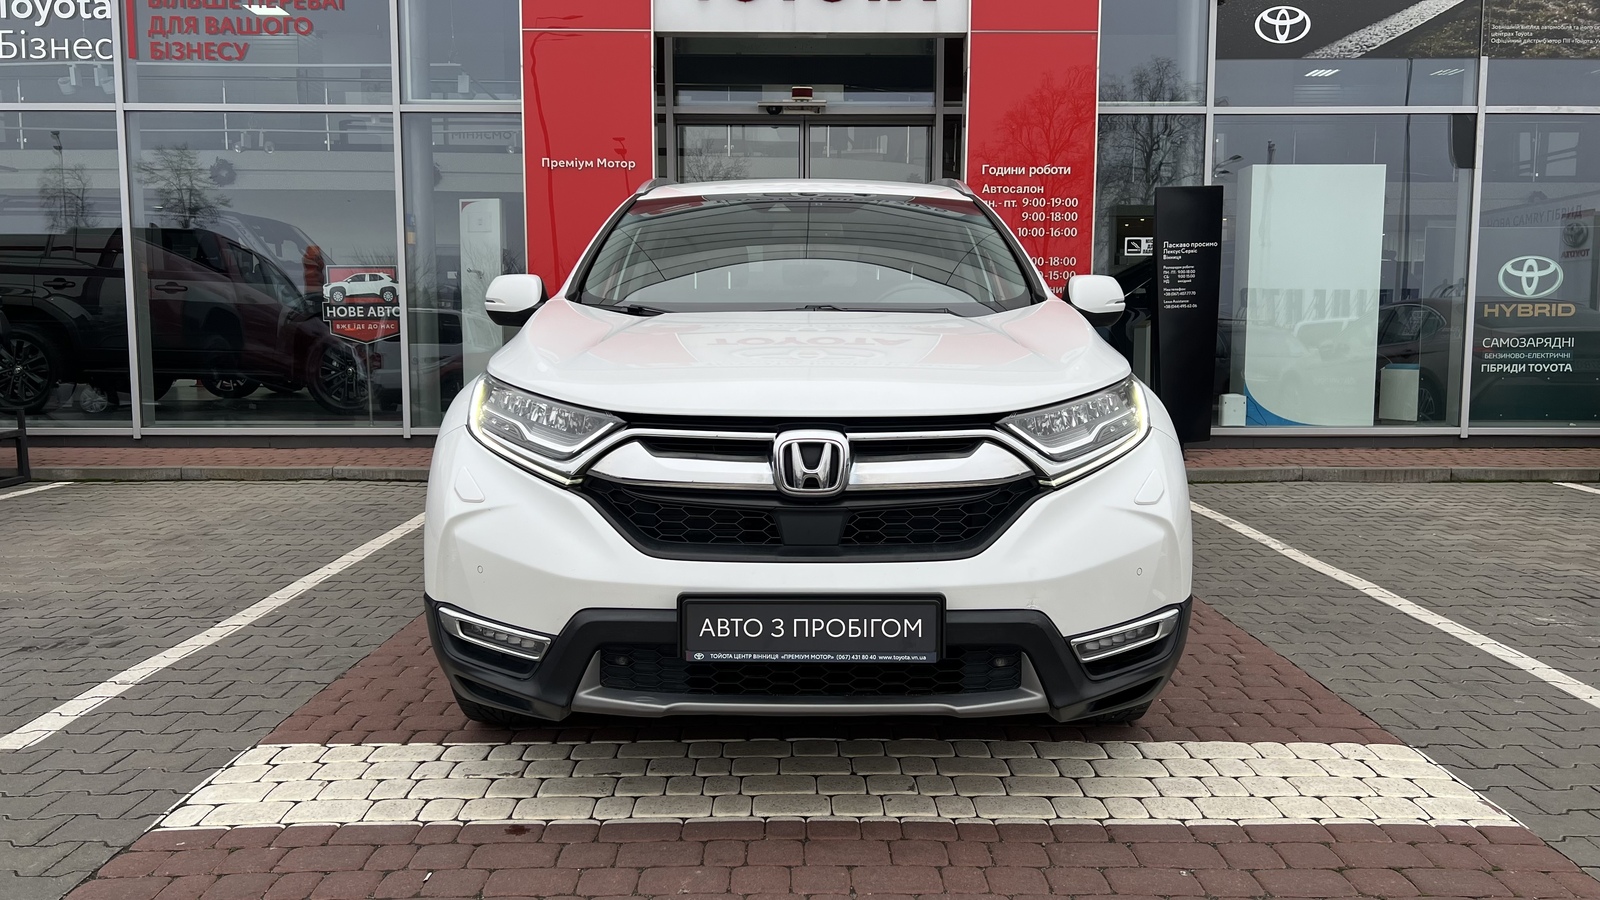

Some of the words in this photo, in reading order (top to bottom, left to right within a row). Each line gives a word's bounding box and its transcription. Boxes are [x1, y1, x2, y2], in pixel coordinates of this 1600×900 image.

[148, 15, 199, 38] ДЛЯ
[204, 16, 314, 36] ВАШОГО
[0, 29, 113, 60] Бізнес
[149, 41, 249, 61] БІЗНЕСУ
[541, 158, 594, 170] Преміум
[597, 158, 636, 170] Мотор
[982, 164, 1026, 176] Години
[1029, 164, 1072, 177] роботи
[982, 184, 1044, 194] Автосалон
[1022, 197, 1079, 208] 9:00-19:00
[1021, 211, 1079, 222] 9:00-18:00
[1017, 227, 1078, 238] 10:00-16:00
[1031, 256, 1077, 267] 00-18:00
[326, 306, 364, 317] НОВЕ
[367, 306, 400, 317] АВТО
[1483, 303, 1576, 318] HYBRID
[1482, 337, 1575, 349] САМОЗАРЯДНІ
[1481, 363, 1526, 374] ГІБРИДИ
[1528, 363, 1573, 373] TOYOTA
[699, 618, 764, 638] АВТО
[770, 618, 785, 638] З
[793, 618, 922, 638] ПРОБІГОМ
[734, 653, 752, 661] ЦЕНТР
[753, 653, 779, 661] ВІННИЦЯ
[878, 654, 927, 662] www.toyota.vn.ua
